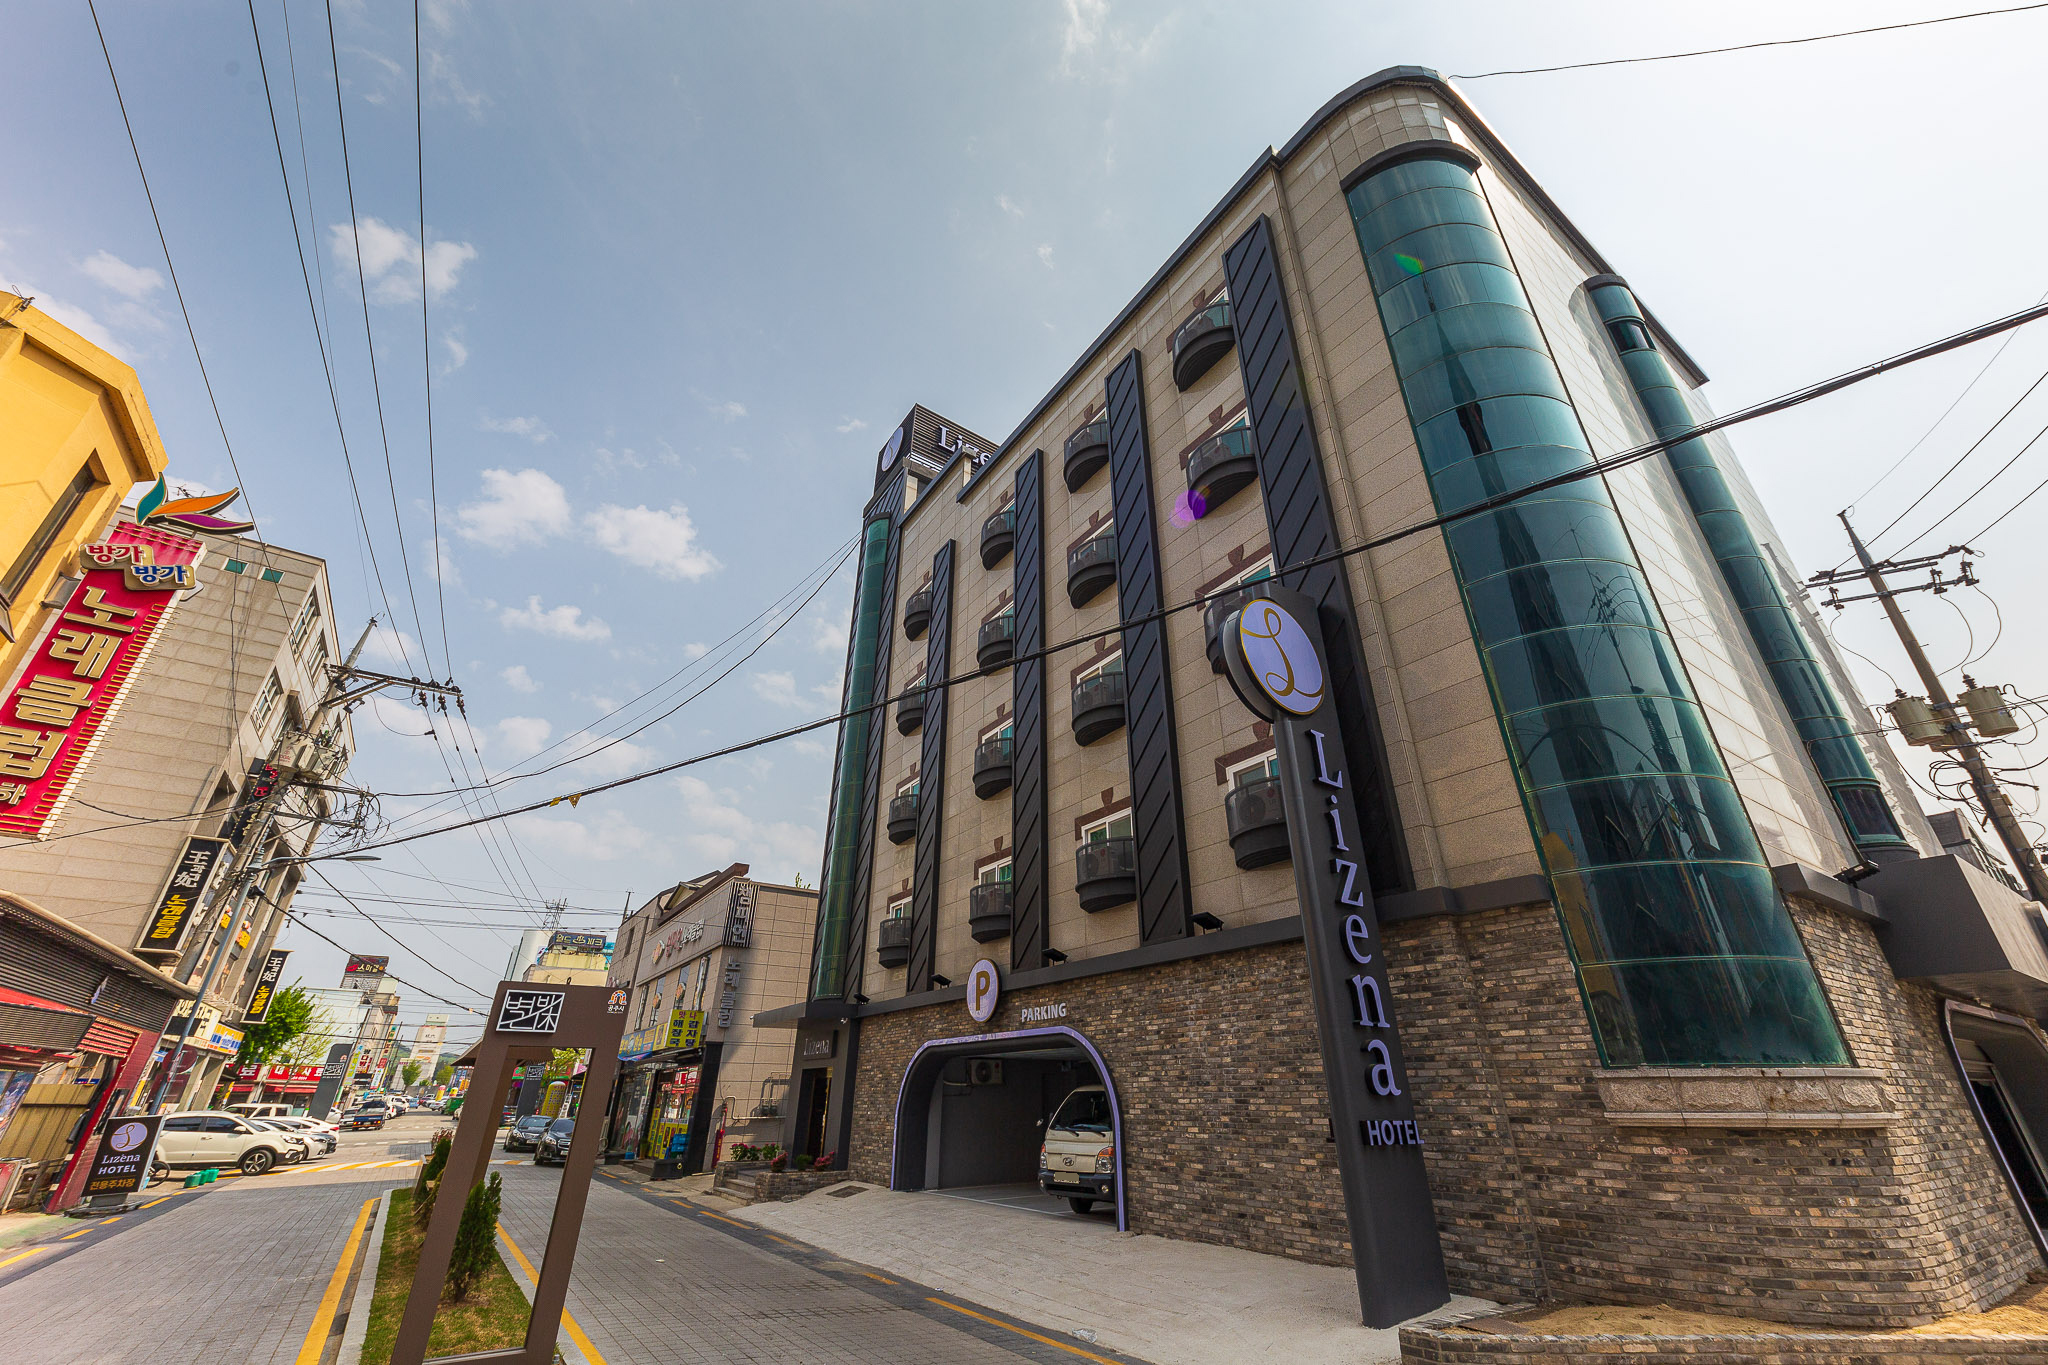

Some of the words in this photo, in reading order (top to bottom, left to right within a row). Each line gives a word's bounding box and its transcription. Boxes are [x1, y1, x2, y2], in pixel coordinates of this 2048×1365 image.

[85, 544, 146, 565] 방가
[132, 564, 191, 584] 방가
[0, 585, 138, 780] 노래클럽
[1308, 728, 1401, 1097] Lizena
[717, 955, 742, 1029] 노래클럽
[1021, 1002, 1067, 1023] PARKING
[1364, 1118, 1425, 1147] HOTEL
[98, 1164, 137, 1175] HOTEL
[90, 1178, 136, 1191] 전용주차장
